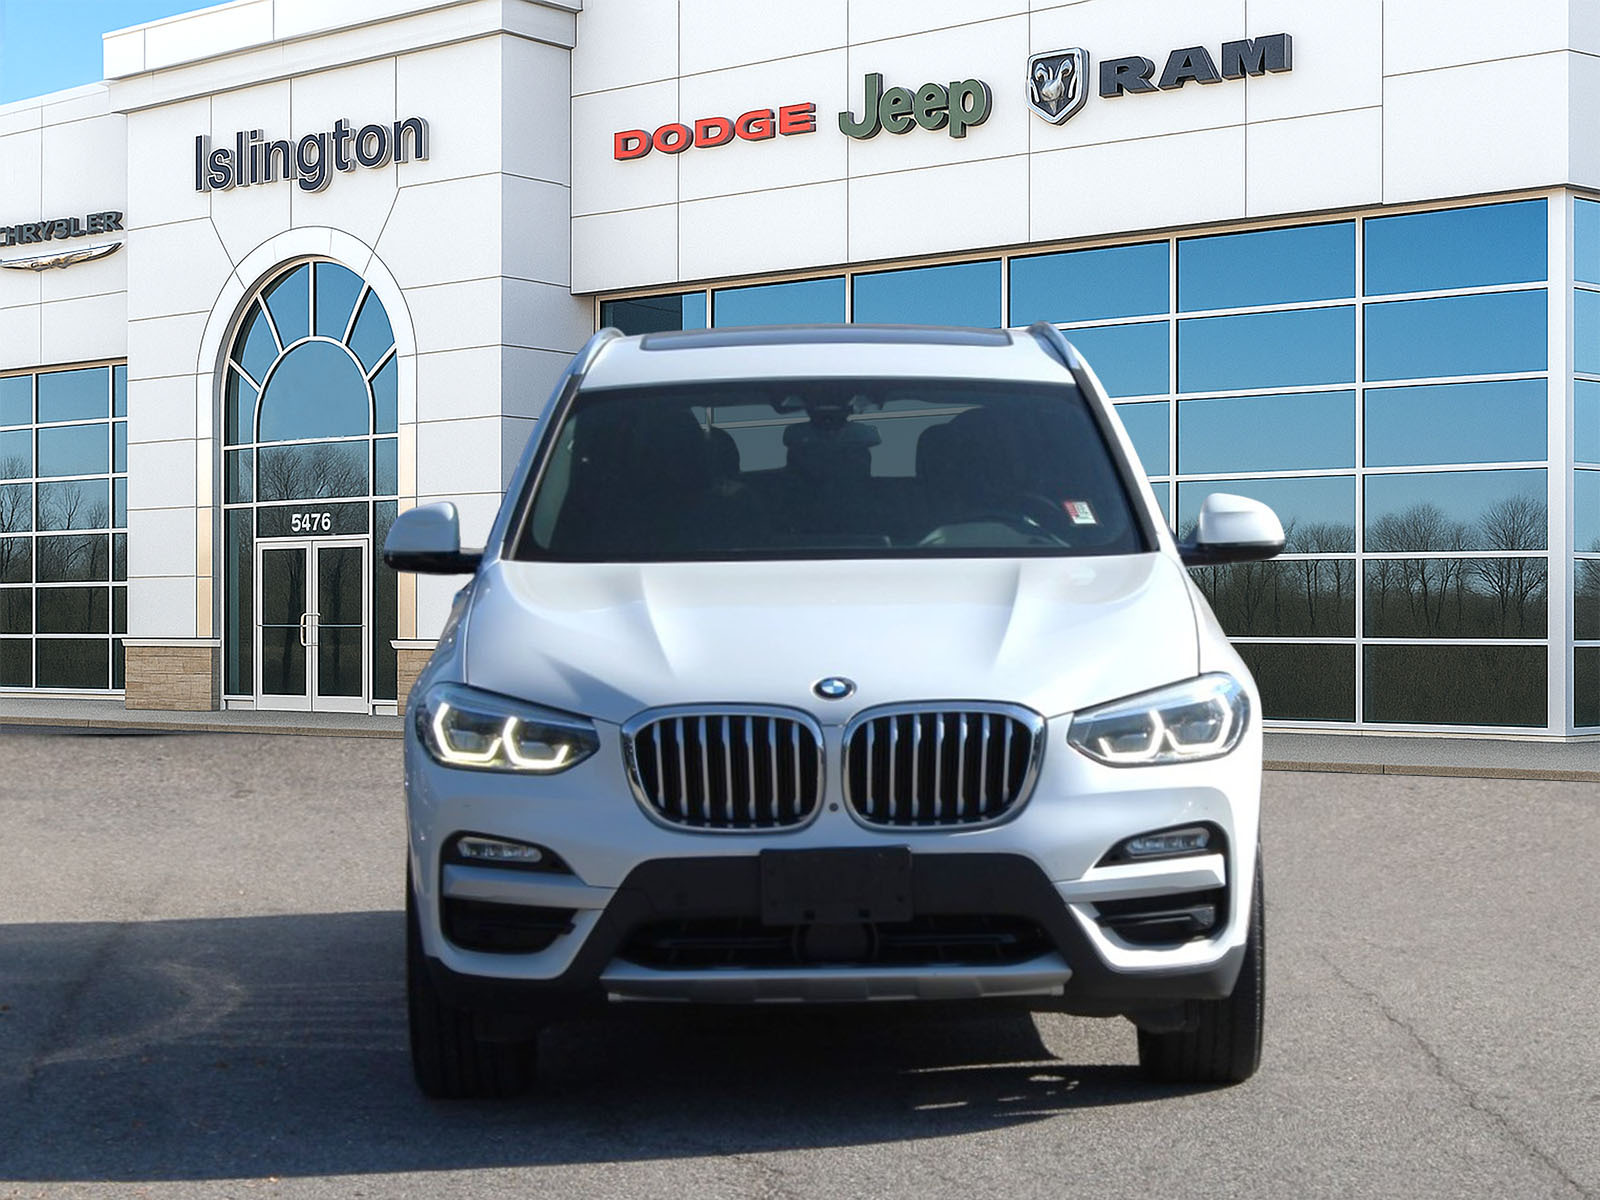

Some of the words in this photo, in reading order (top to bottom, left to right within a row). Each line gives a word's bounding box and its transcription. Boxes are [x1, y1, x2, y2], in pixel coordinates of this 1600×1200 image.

[1099, 33, 1293, 98] RAM
[614, 102, 817, 161] DODGE
[838, 73, 993, 139] Jeep
[195, 115, 429, 193] Islington
[291, 512, 331, 532] 5476
